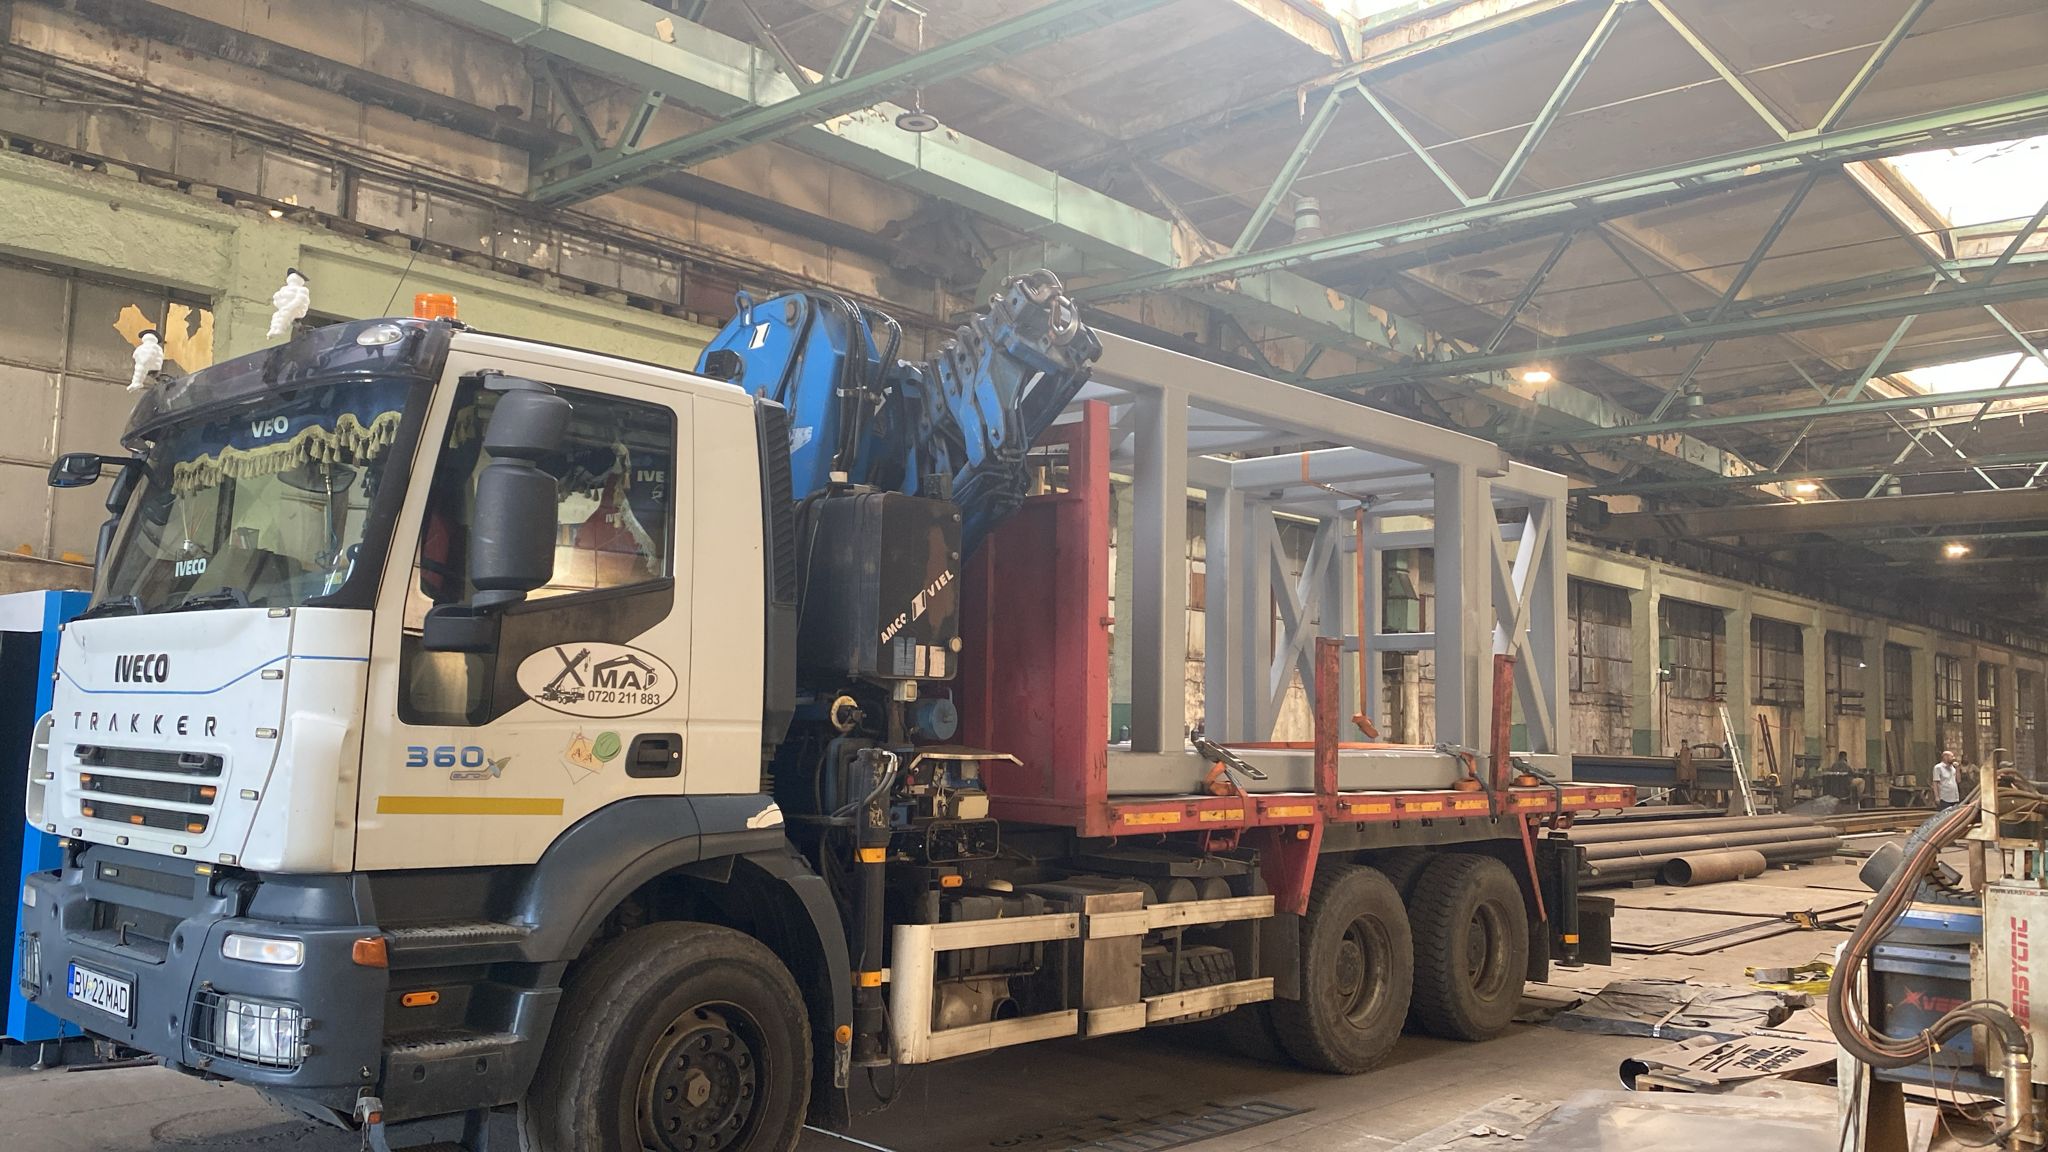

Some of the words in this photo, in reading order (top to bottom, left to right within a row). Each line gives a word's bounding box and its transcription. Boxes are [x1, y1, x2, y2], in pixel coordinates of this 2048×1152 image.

[175, 558, 207, 577] IVECO
[927, 569, 954, 597] VIEL
[115, 653, 170, 683] IVECO
[588, 690, 616, 703] 0720
[618, 691, 637, 704] 211
[640, 693, 660, 705] 883
[74, 711, 218, 737] TRAKKER
[405, 745, 485, 768] 360
[75, 971, 89, 999] BV
[92, 977, 104, 1005] 22
[106, 981, 128, 1013] MAD
